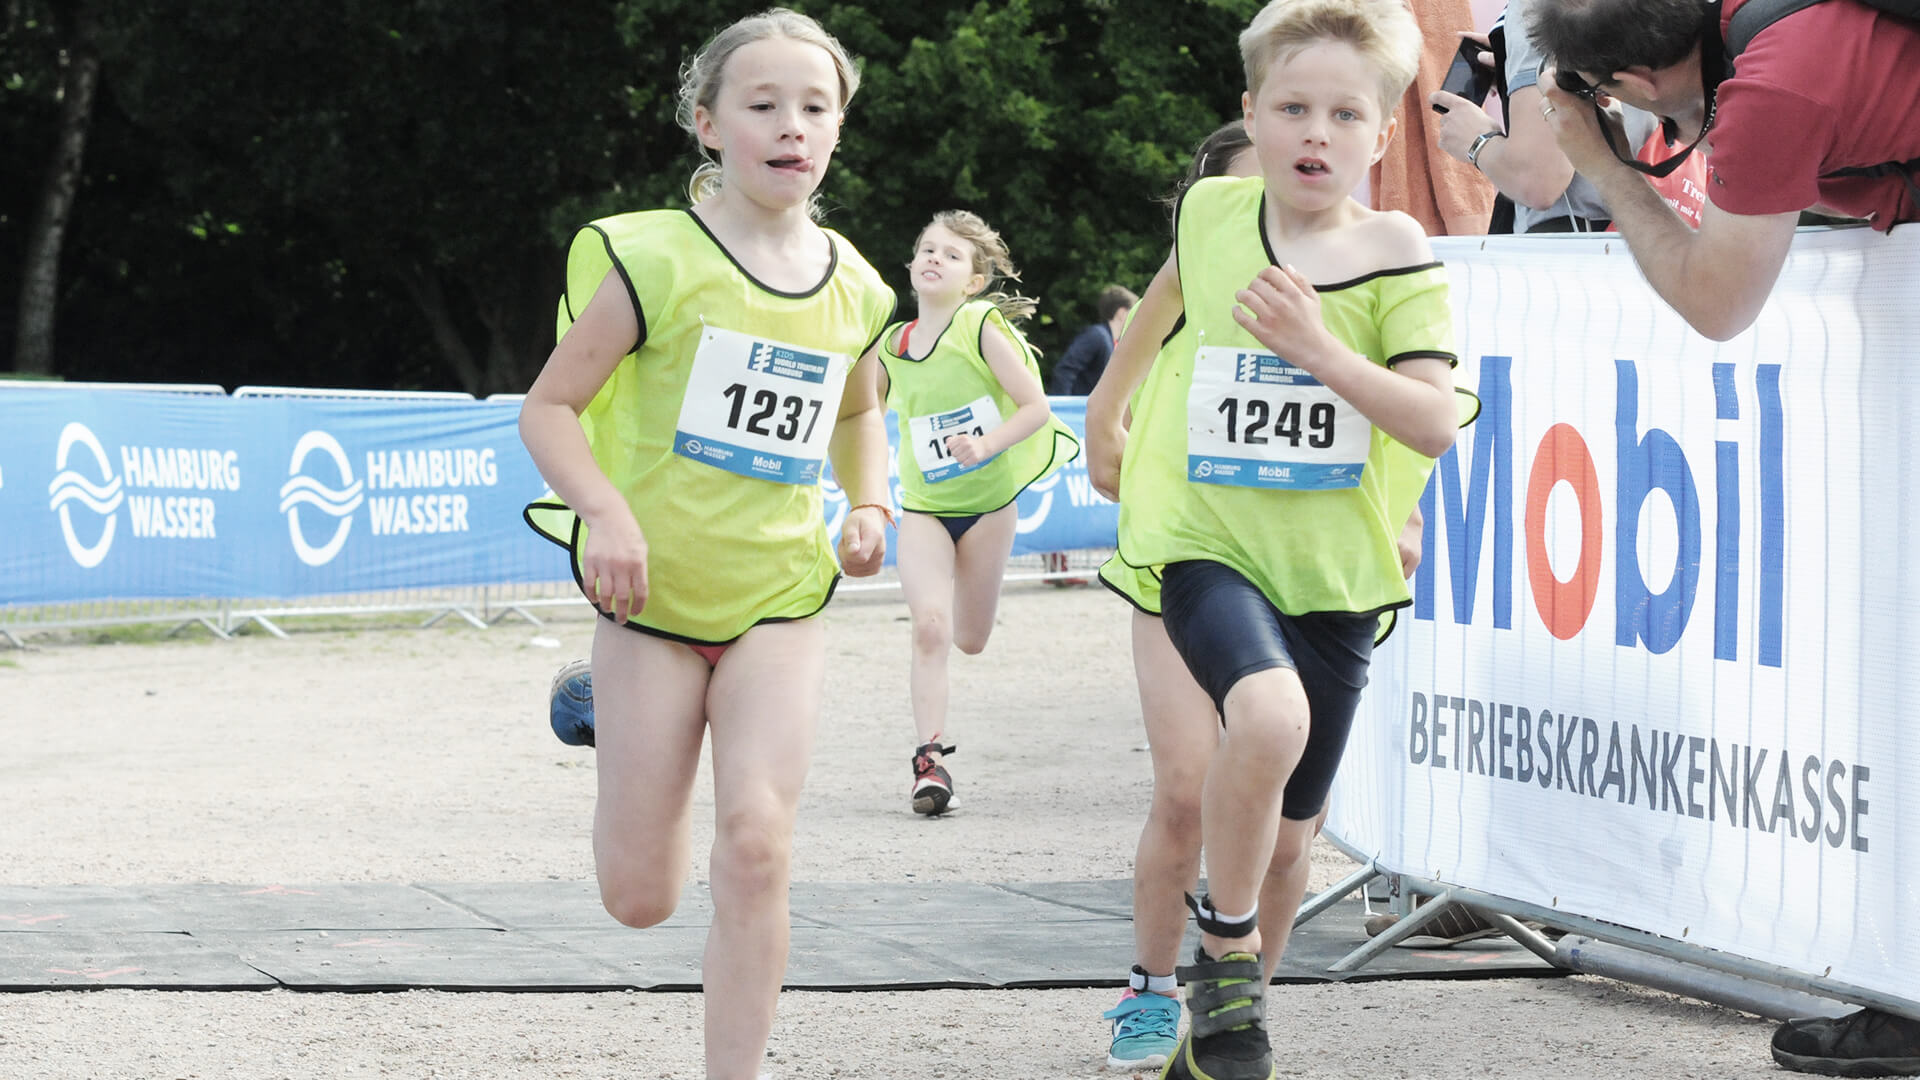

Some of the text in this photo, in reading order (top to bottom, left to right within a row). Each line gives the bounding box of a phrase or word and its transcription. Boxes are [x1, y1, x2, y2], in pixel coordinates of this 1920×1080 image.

[774, 357, 797, 369] WORLD
[775, 350, 794, 360] KIDS
[1259, 365, 1283, 375] WORLD
[1260, 357, 1280, 366] KIDS
[723, 382, 823, 444] 1237
[1218, 397, 1336, 449] 1249
[120, 445, 240, 491] HAMBURG
[366, 448, 498, 490] HAMBURG
[752, 455, 782, 471] Mobil
[1258, 466, 1290, 478] Mobil
[128, 495, 216, 538] WASSER
[368, 494, 469, 536] WASSER
[1414, 355, 1784, 668] Mobil
[1409, 691, 1871, 853] BETRIEBSKRANKENKASSE
